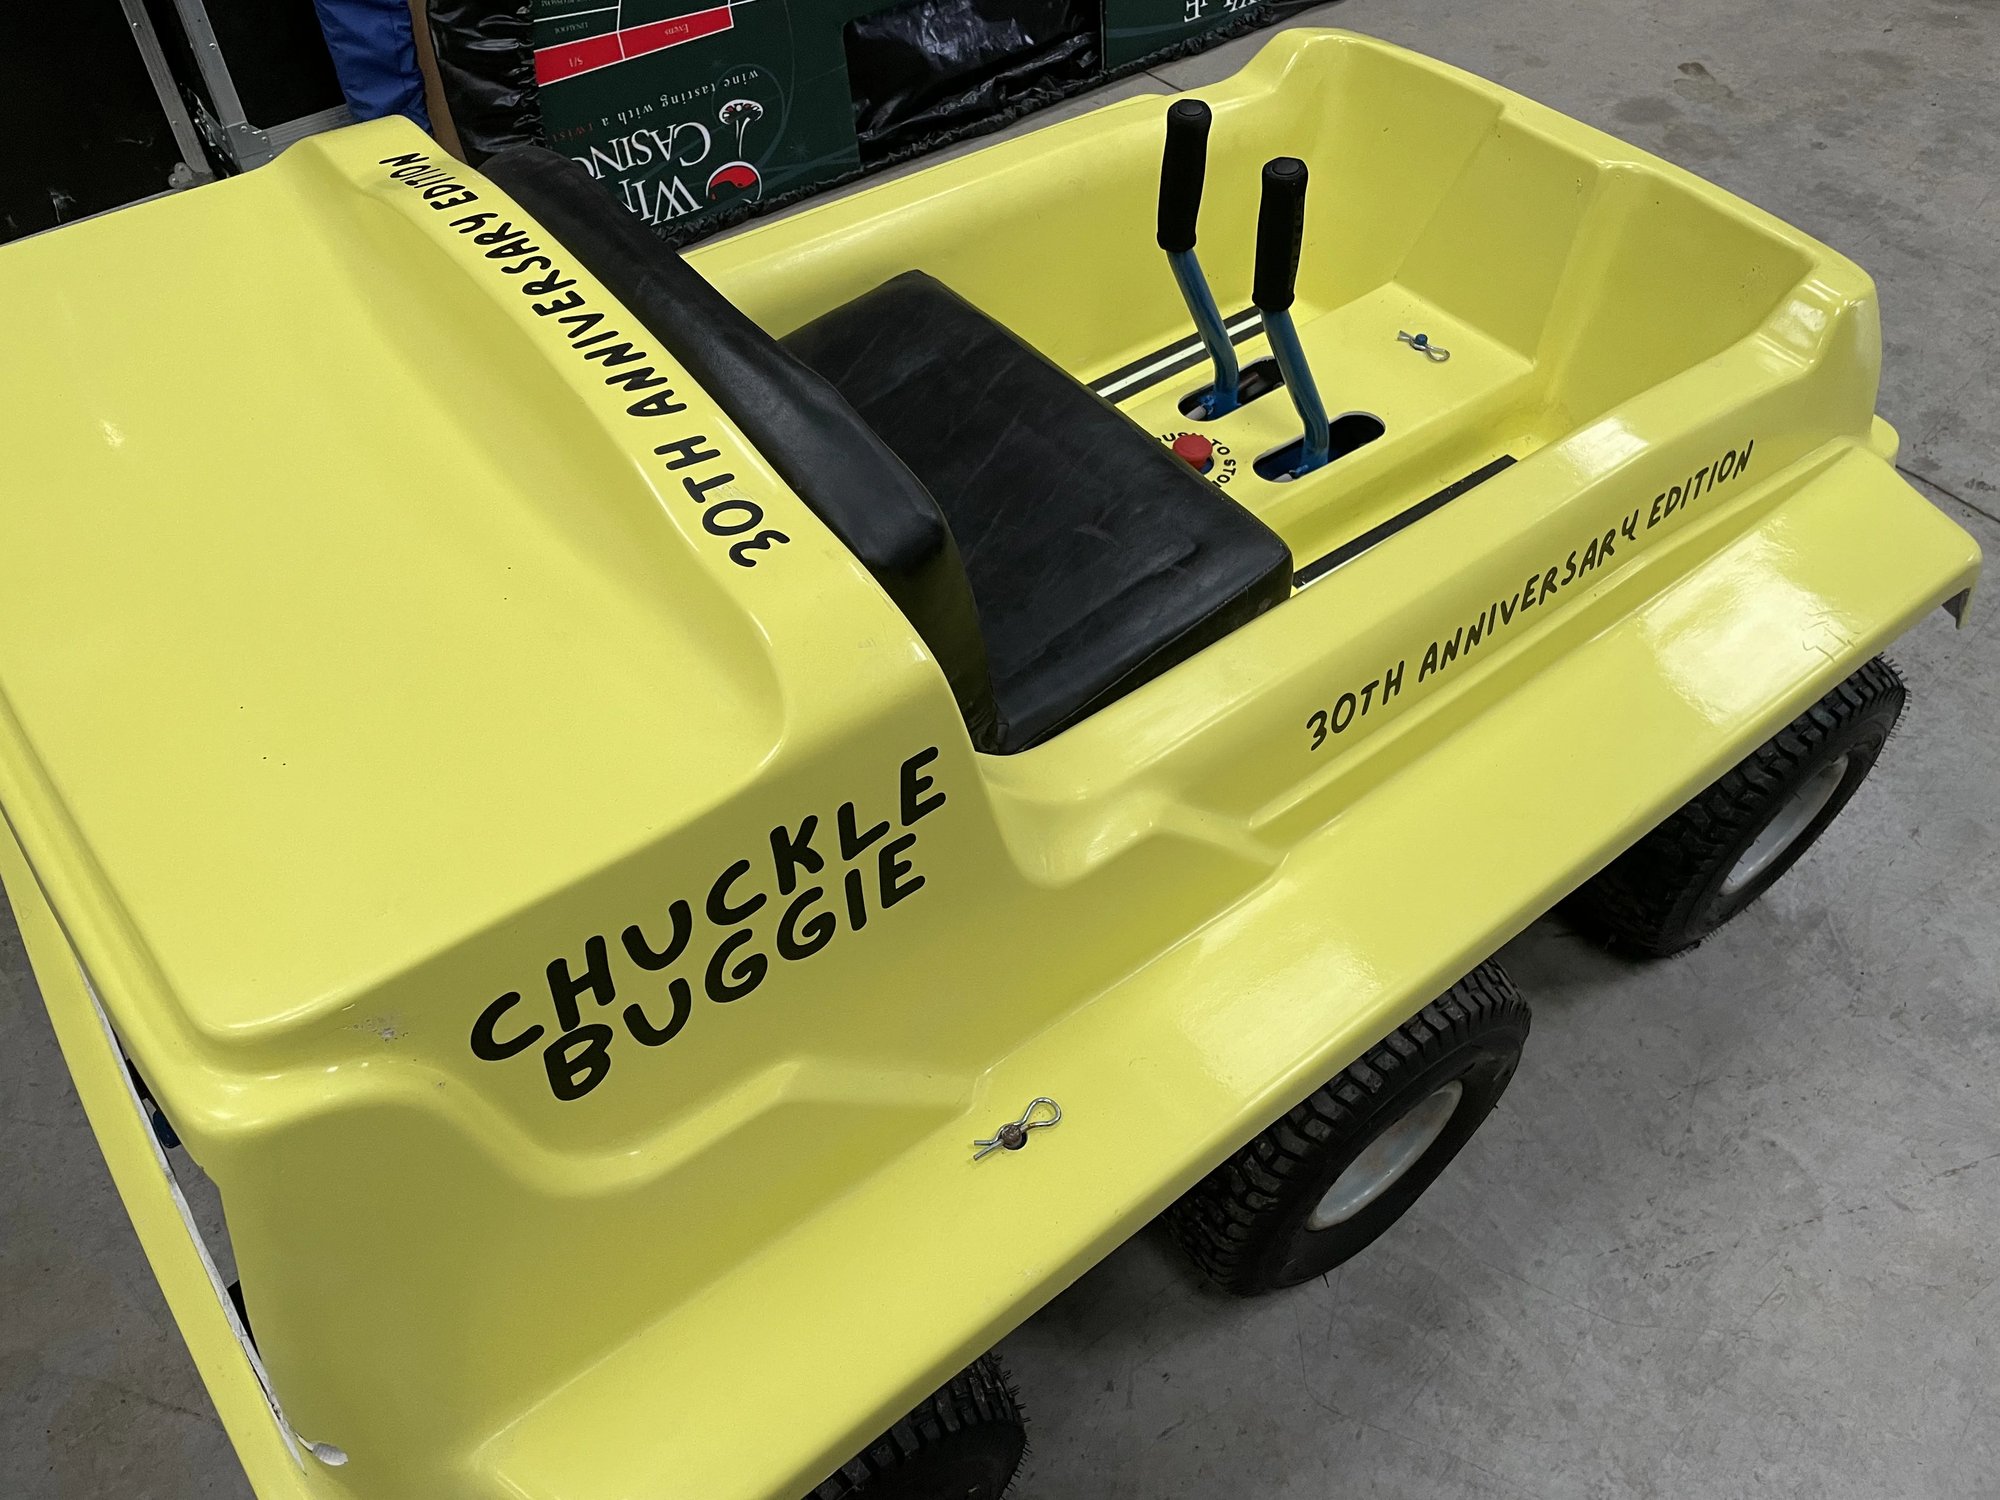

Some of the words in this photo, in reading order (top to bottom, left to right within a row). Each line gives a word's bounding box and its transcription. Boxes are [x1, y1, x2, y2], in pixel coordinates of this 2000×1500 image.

[664, 23, 690, 36] Evens
[568, 57, 584, 67] 5/1
[723, 69, 759, 88] wine
[618, 104, 653, 125] with
[660, 83, 717, 108] tasting
[601, 117, 609, 127] a
[378, 152, 479, 211] EDITION
[449, 212, 688, 418] ANNIVERSARY
[654, 435, 791, 568] 30TH
[1306, 660, 1405, 752] 30TH
[1418, 508, 1639, 683] ANNIVERSARY
[1646, 439, 1754, 530] EDITION
[470, 746, 947, 1061] CHUCKLE
[543, 833, 926, 1102] BUGGIE
